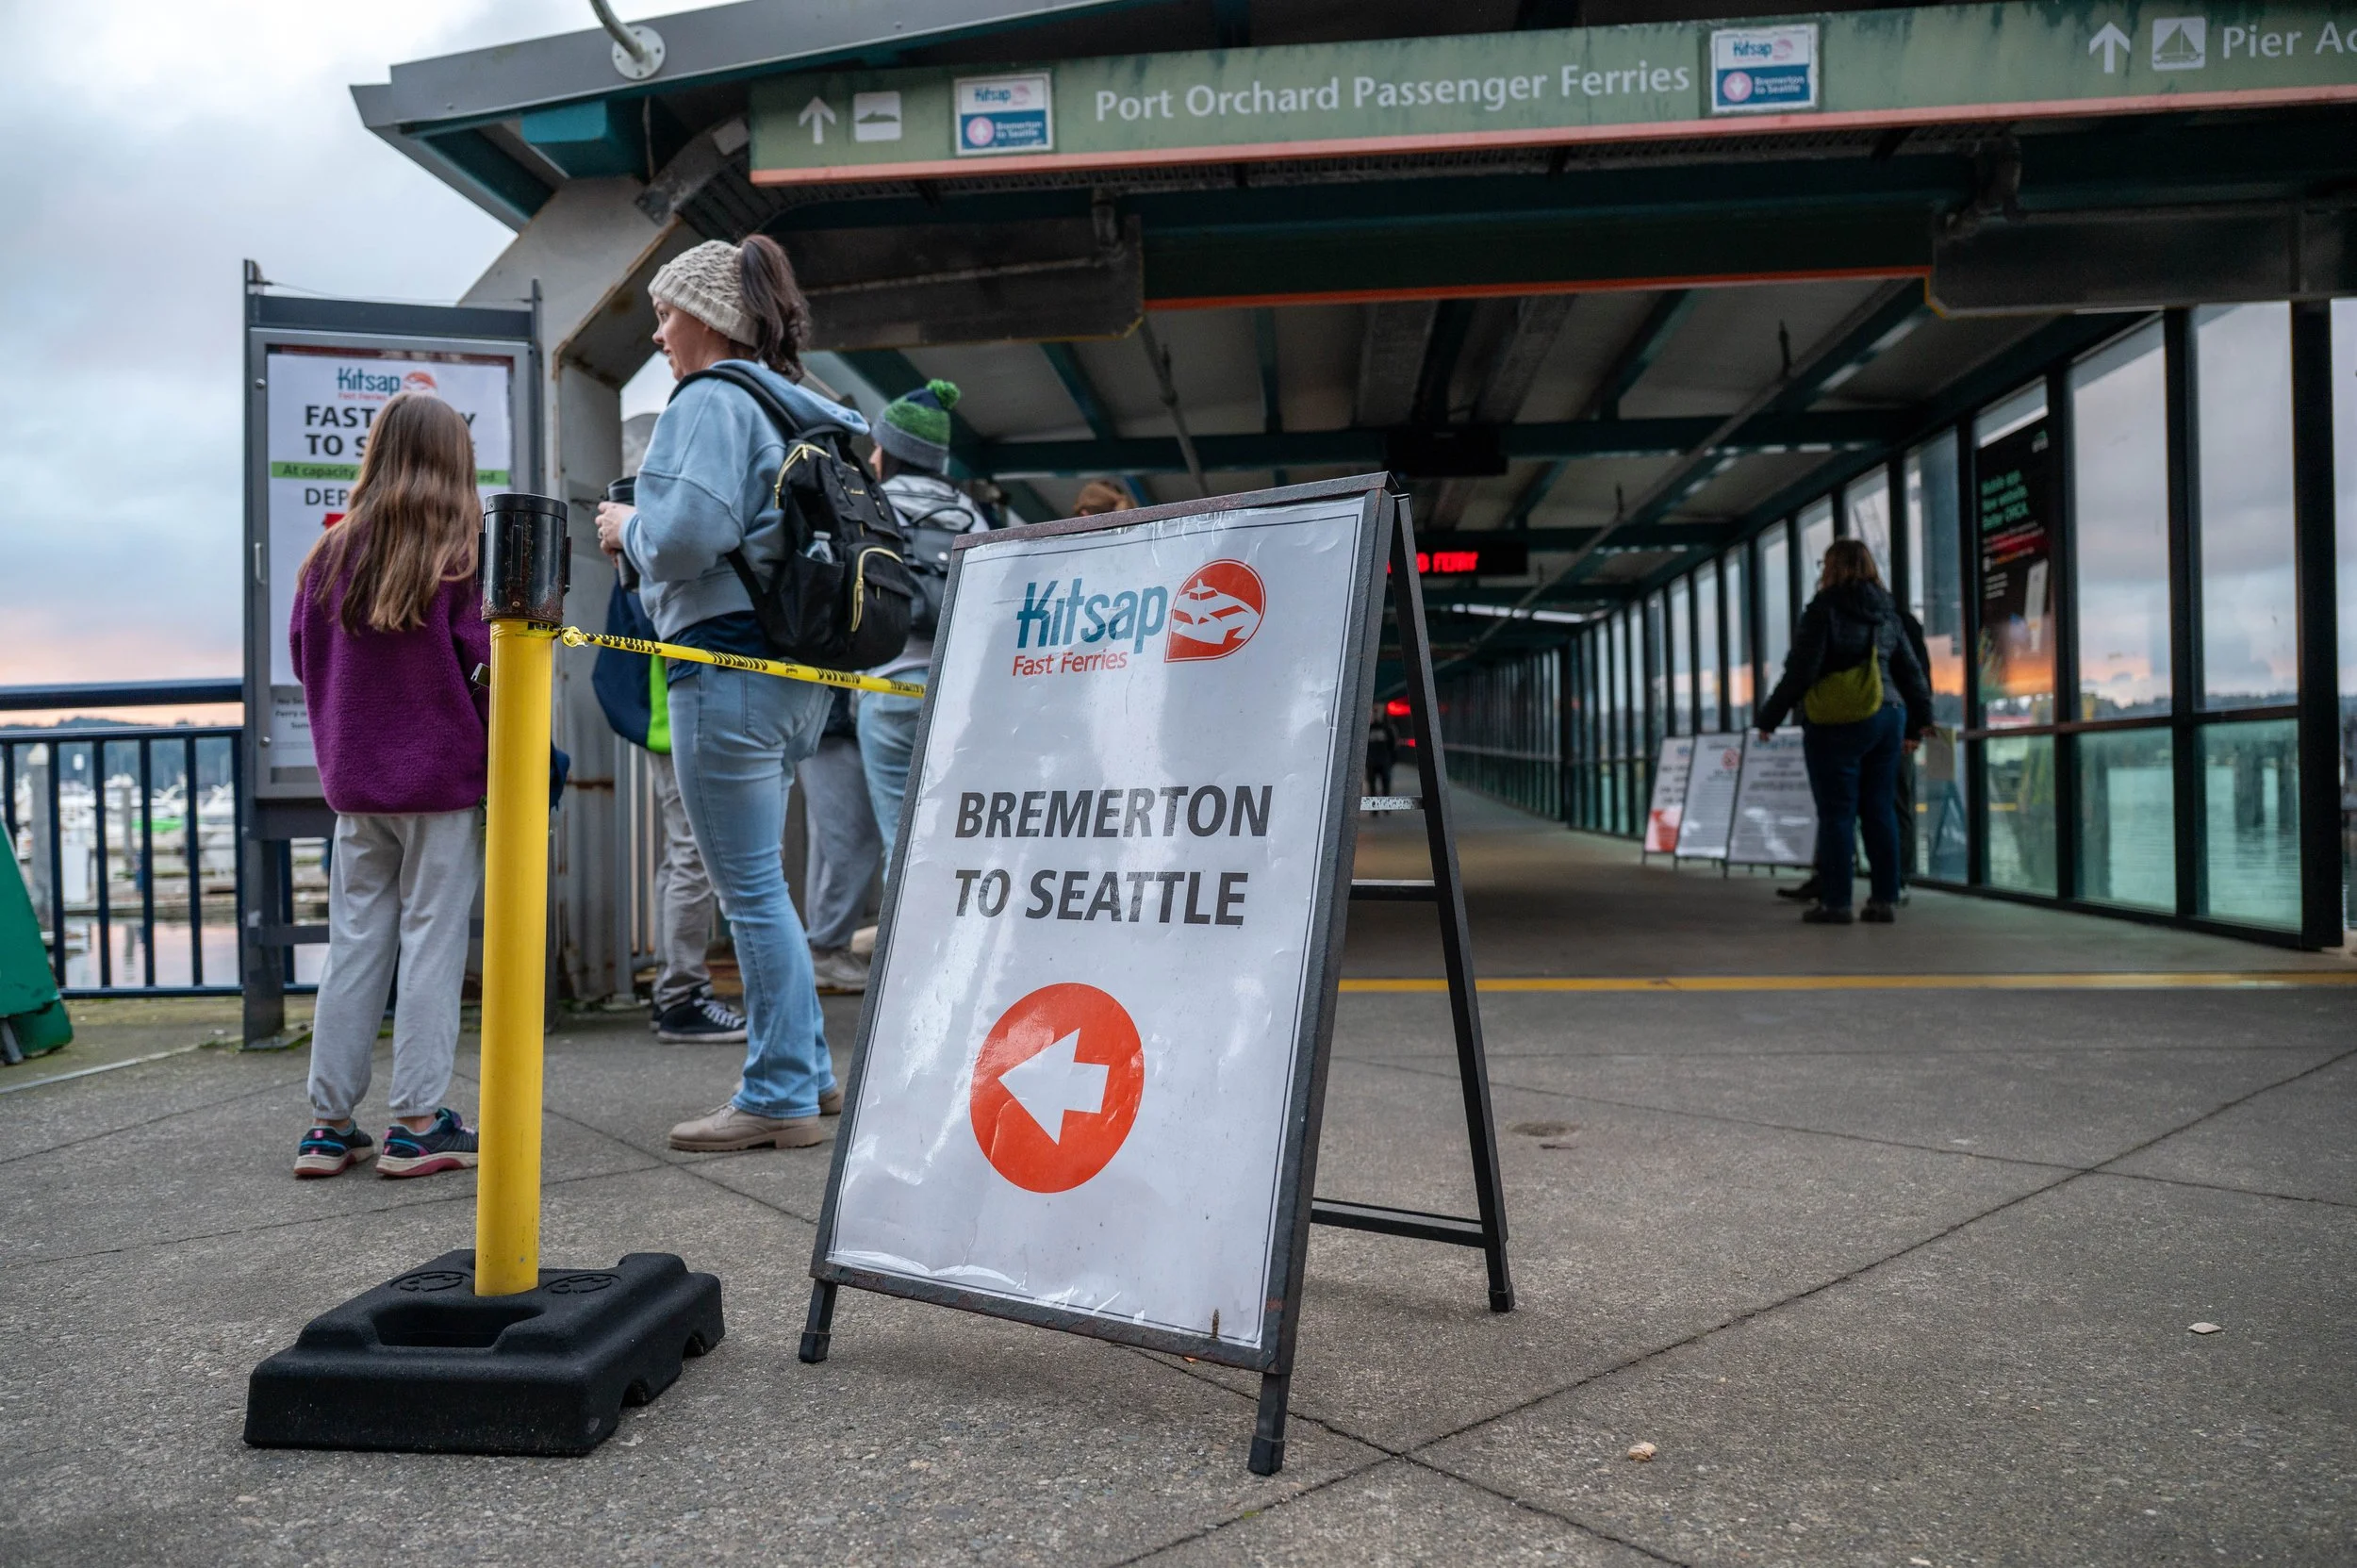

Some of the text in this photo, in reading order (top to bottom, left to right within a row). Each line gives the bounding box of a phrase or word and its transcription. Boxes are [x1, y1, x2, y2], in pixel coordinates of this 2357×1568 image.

[2223, 25, 2301, 59] Pier
[1096, 60, 1690, 122] Port Orchard Passenger Ferries
[337, 368, 401, 396] Kitsap
[305, 405, 376, 428] FAST
[305, 435, 344, 456] TO
[1016, 577, 1168, 653] Kitsap
[1012, 649, 1128, 677] Fast Ferries
[954, 784, 1273, 838] BREMERTON
[955, 869, 1248, 927] TO SEATTLE
